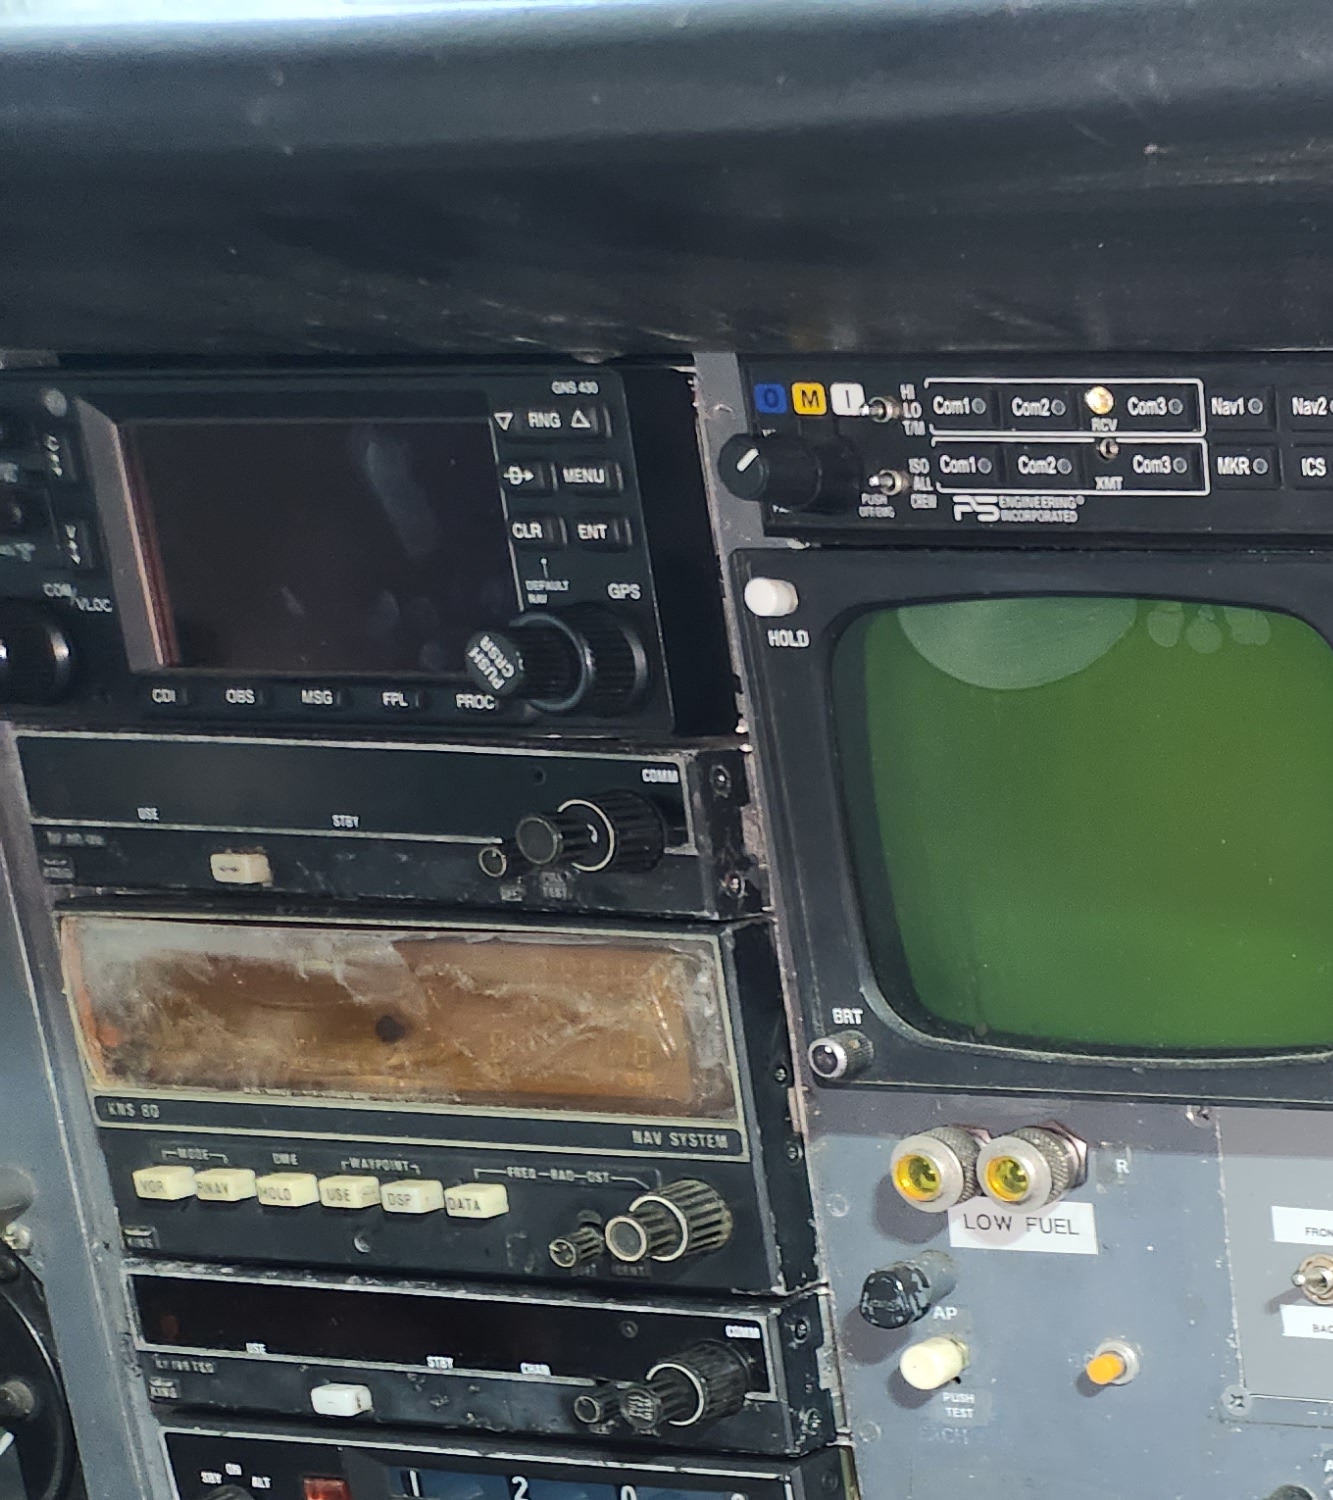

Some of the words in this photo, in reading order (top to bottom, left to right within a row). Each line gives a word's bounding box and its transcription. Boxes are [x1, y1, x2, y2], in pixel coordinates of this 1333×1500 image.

[801, 389, 820, 407] M
[1128, 397, 1167, 415] Com3
[933, 398, 970, 415] Com1
[1012, 399, 1051, 417] Com2
[1212, 399, 1244, 415] Nav1
[1292, 399, 1327, 416] Nav2
[528, 413, 561, 428] RNG
[1218, 458, 1250, 475] MKR
[1302, 458, 1326, 476] ICS
[563, 468, 604, 483] MENU
[1002, 510, 1078, 523] INCORPORATED
[512, 523, 542, 539] CLR
[578, 524, 607, 539] ENT
[608, 584, 641, 600] GPS
[768, 631, 809, 648] HOLD
[456, 693, 495, 710] PROC
[633, 1131, 662, 1145] NAV
[670, 1133, 728, 1149] SYSTEM
[349, 1158, 409, 1172] WAYPOINT
[327, 1189, 349, 1201] USE
[387, 1192, 412, 1206] DSP
[449, 1197, 481, 1211] DATA
[964, 1214, 1012, 1231] LOW
[1026, 1217, 1080, 1235] FUEL
[933, 1306, 957, 1319] AP
[943, 1393, 975, 1403] PUSH
[945, 1408, 974, 1418] TEST
